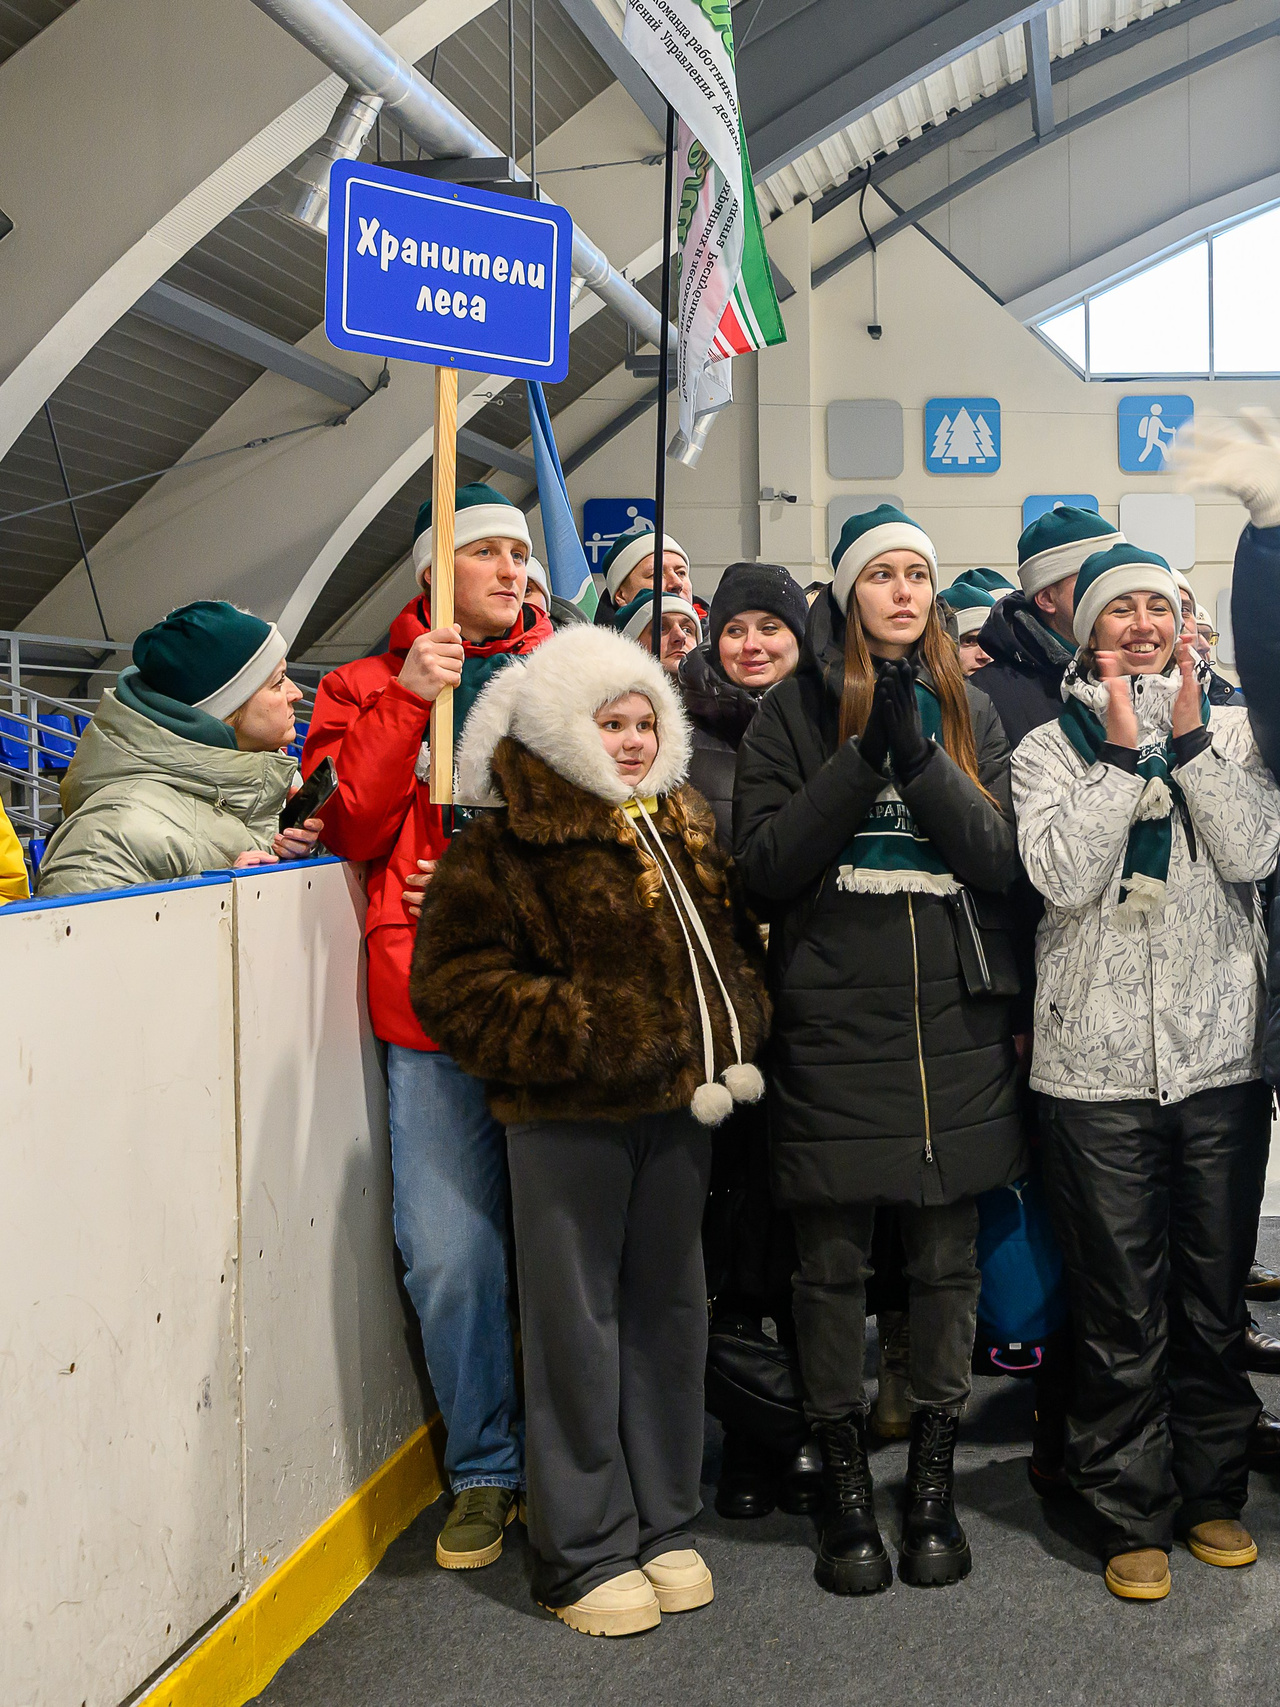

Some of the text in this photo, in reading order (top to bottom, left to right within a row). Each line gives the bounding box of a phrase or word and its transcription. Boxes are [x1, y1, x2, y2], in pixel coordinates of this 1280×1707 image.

[660, 30, 716, 100] Управления
[356, 216, 546, 290] Хранители
[416, 285, 487, 323] леса
